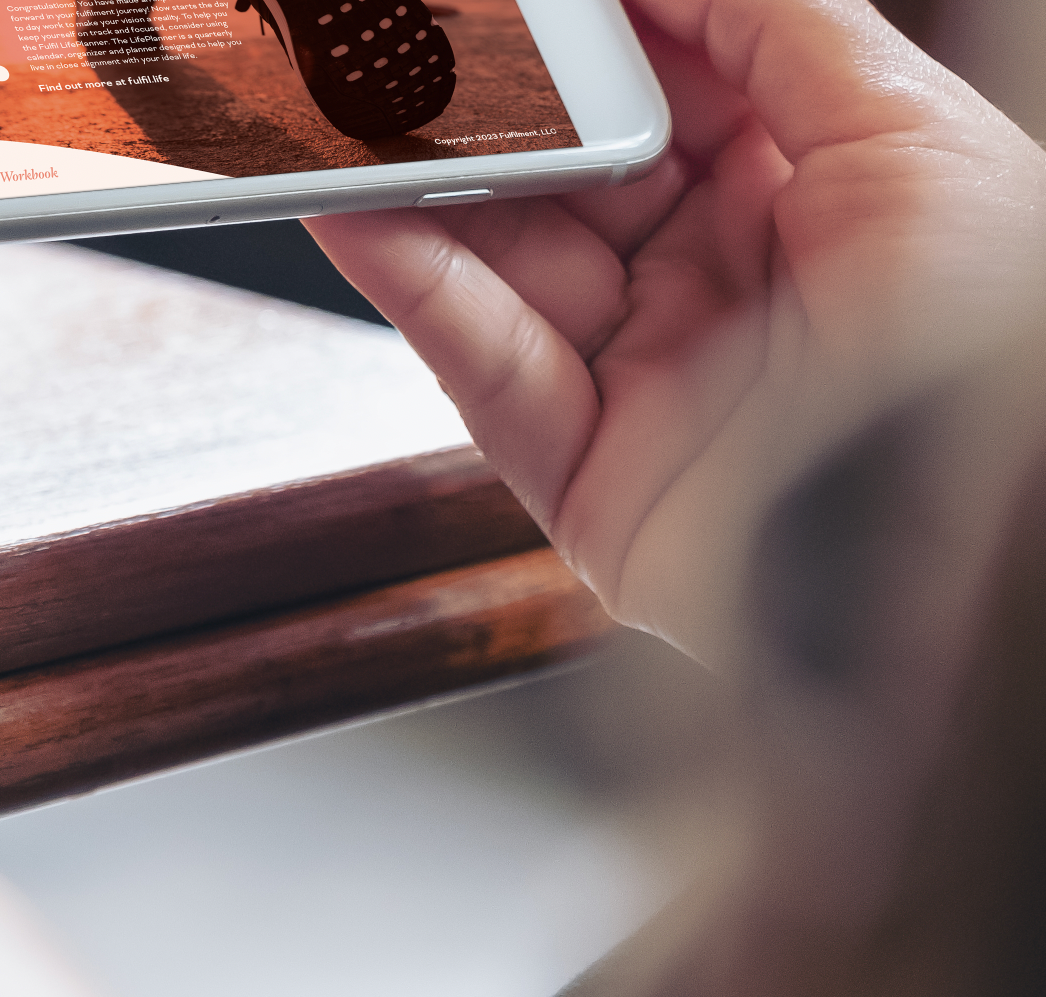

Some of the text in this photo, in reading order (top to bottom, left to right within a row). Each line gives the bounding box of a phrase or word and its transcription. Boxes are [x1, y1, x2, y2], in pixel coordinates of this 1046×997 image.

[7, 1, 76, 13] Congratulations!
[11, 13, 44, 22] forward
[116, 7, 150, 16] journey!
[214, 1, 229, 9] day
[18, 34, 39, 42] keep
[41, 31, 75, 41] yourself
[134, 25, 167, 33] focused,
[26, 24, 40, 32] day
[100, 19, 119, 27] your
[38, 42, 59, 50] Fulfil
[60, 40, 110, 49] LifePlanner.
[129, 34, 177, 44] LifePlanner
[195, 30, 232, 40] quarterly
[27, 53, 66, 61] calendar,
[67, 49, 106, 59] organizer
[126, 46, 157, 55] planner
[159, 42, 196, 51] designed
[81, 58, 121, 69] alignment
[122, 56, 139, 64] with
[141, 56, 159, 64] your
[161, 53, 181, 61] ideal
[38, 74, 169, 92] Find out more at fulfil.life
[435, 136, 475, 145] Copyright
[499, 129, 540, 139] Fulfilment,
[0, 167, 58, 183] Workbook
